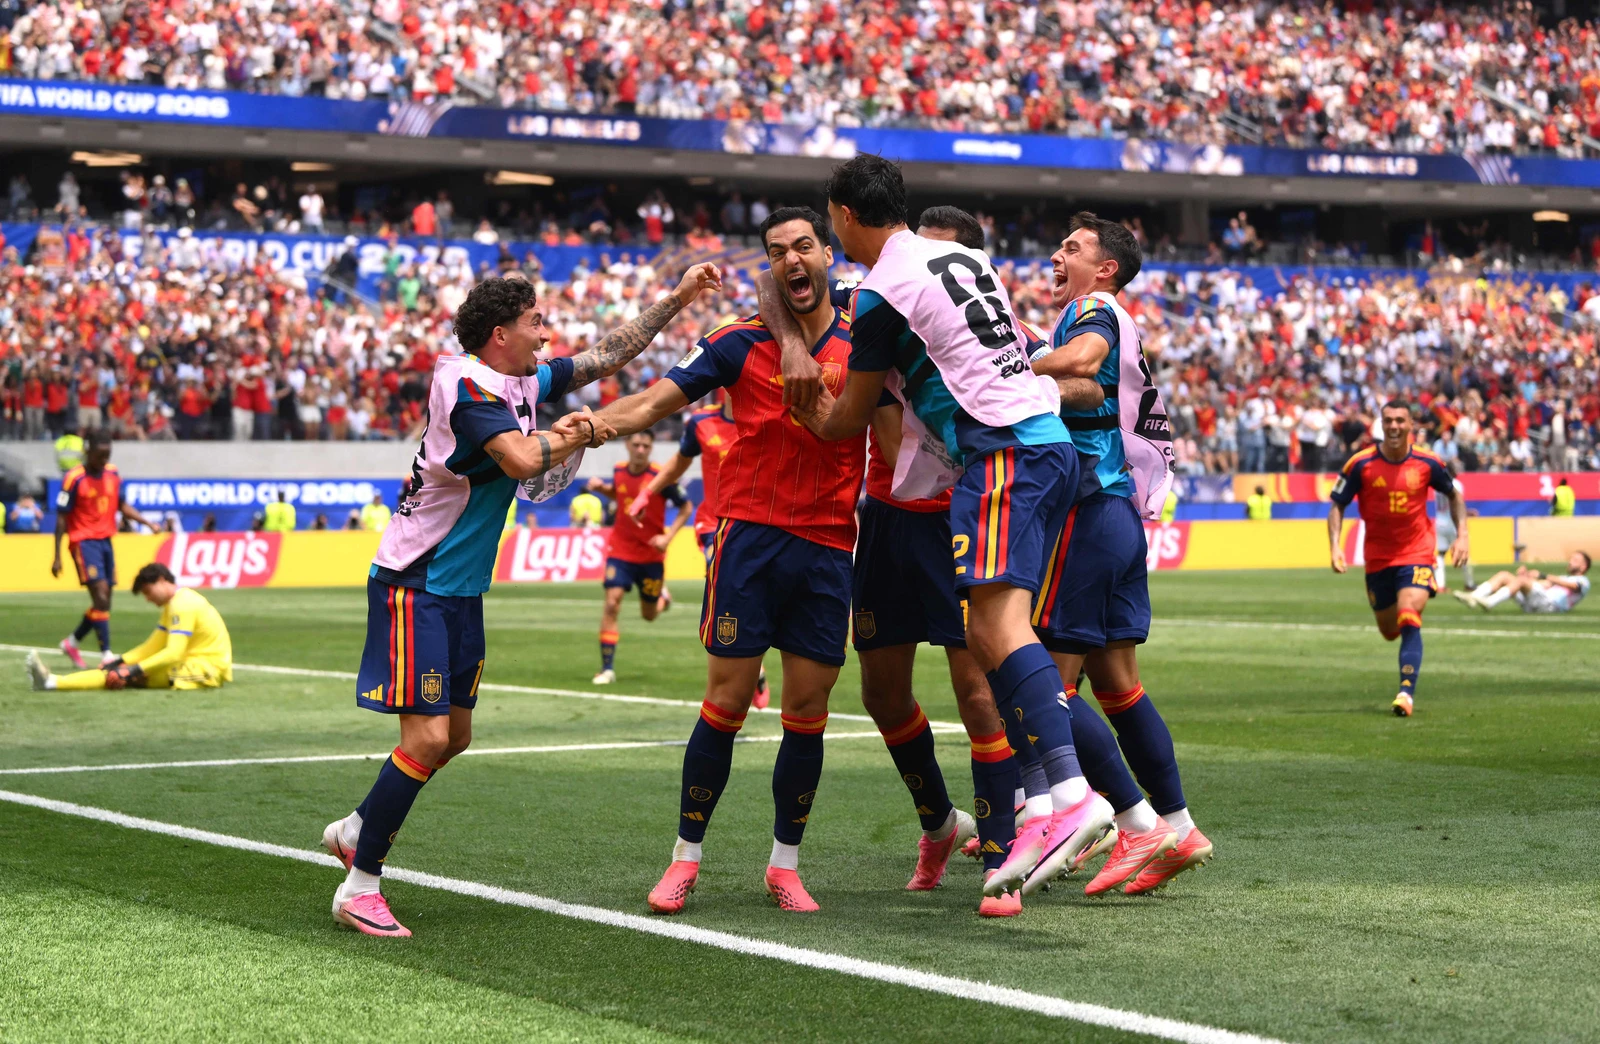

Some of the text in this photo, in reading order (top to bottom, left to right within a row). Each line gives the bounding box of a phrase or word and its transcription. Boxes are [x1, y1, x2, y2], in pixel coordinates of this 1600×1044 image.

[36, 86, 112, 111] WORLD
[113, 91, 156, 114] CUP
[156, 93, 229, 119] 2026
[1143, 418, 1170, 432] FIFA
[126, 482, 374, 506] FIFA WORLD CUP 2026
[1389, 491, 1408, 513] 12
[169, 529, 270, 589] Lay's
[511, 526, 605, 582] Lay's
[1412, 565, 1432, 587] 12
